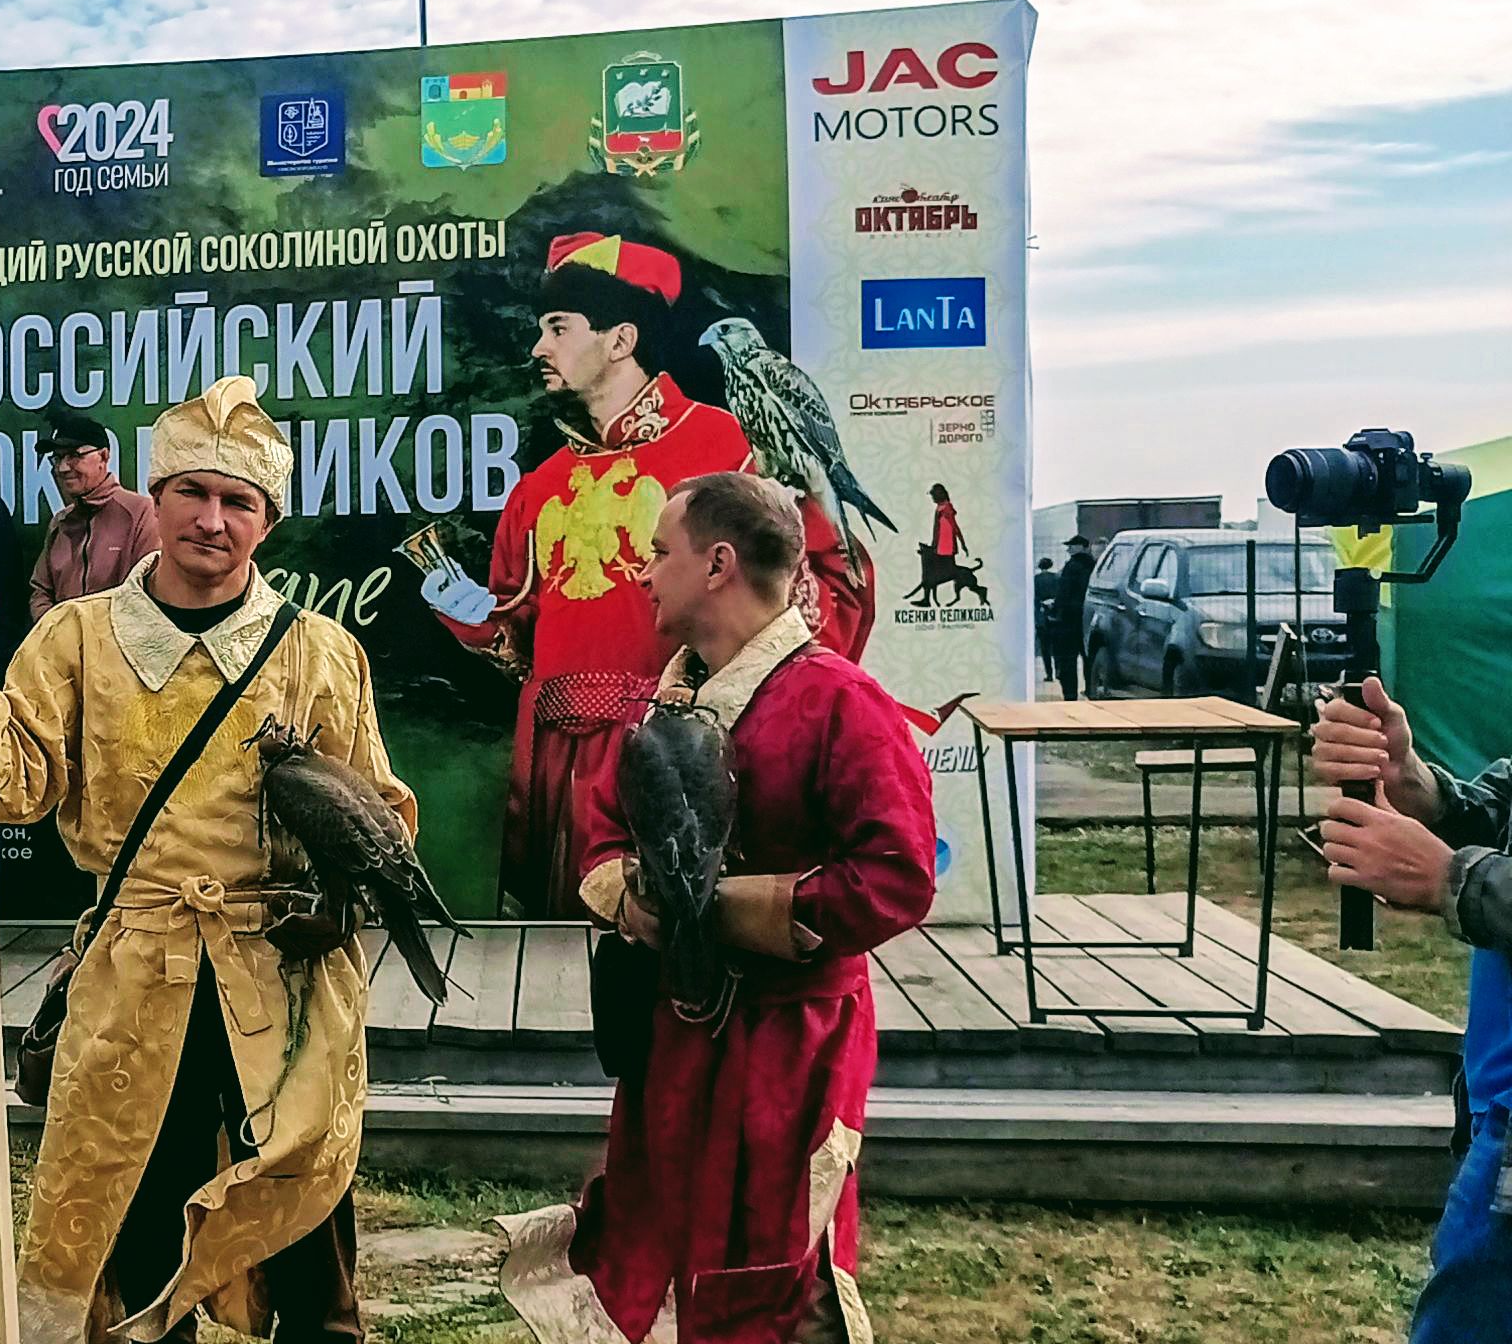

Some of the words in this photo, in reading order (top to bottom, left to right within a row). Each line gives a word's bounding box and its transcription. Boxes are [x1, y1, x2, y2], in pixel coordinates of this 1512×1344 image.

[812, 42, 998, 95] JAC
[56, 98, 174, 163] 2024
[814, 104, 999, 142] MOTORS
[855, 205, 978, 232] ОКТЯБРЬ
[55, 232, 192, 280] РУССКОЙ
[200, 220, 388, 273] СОКОЛИНОЙ
[396, 220, 506, 263] ОХОТЫ
[938, 422, 976, 433] ЗЕРНО
[938, 433, 983, 445] ДОРОГО
[895, 609, 936, 624] КСЕНИЯ
[940, 608, 994, 623] СЕЛИХОВА
